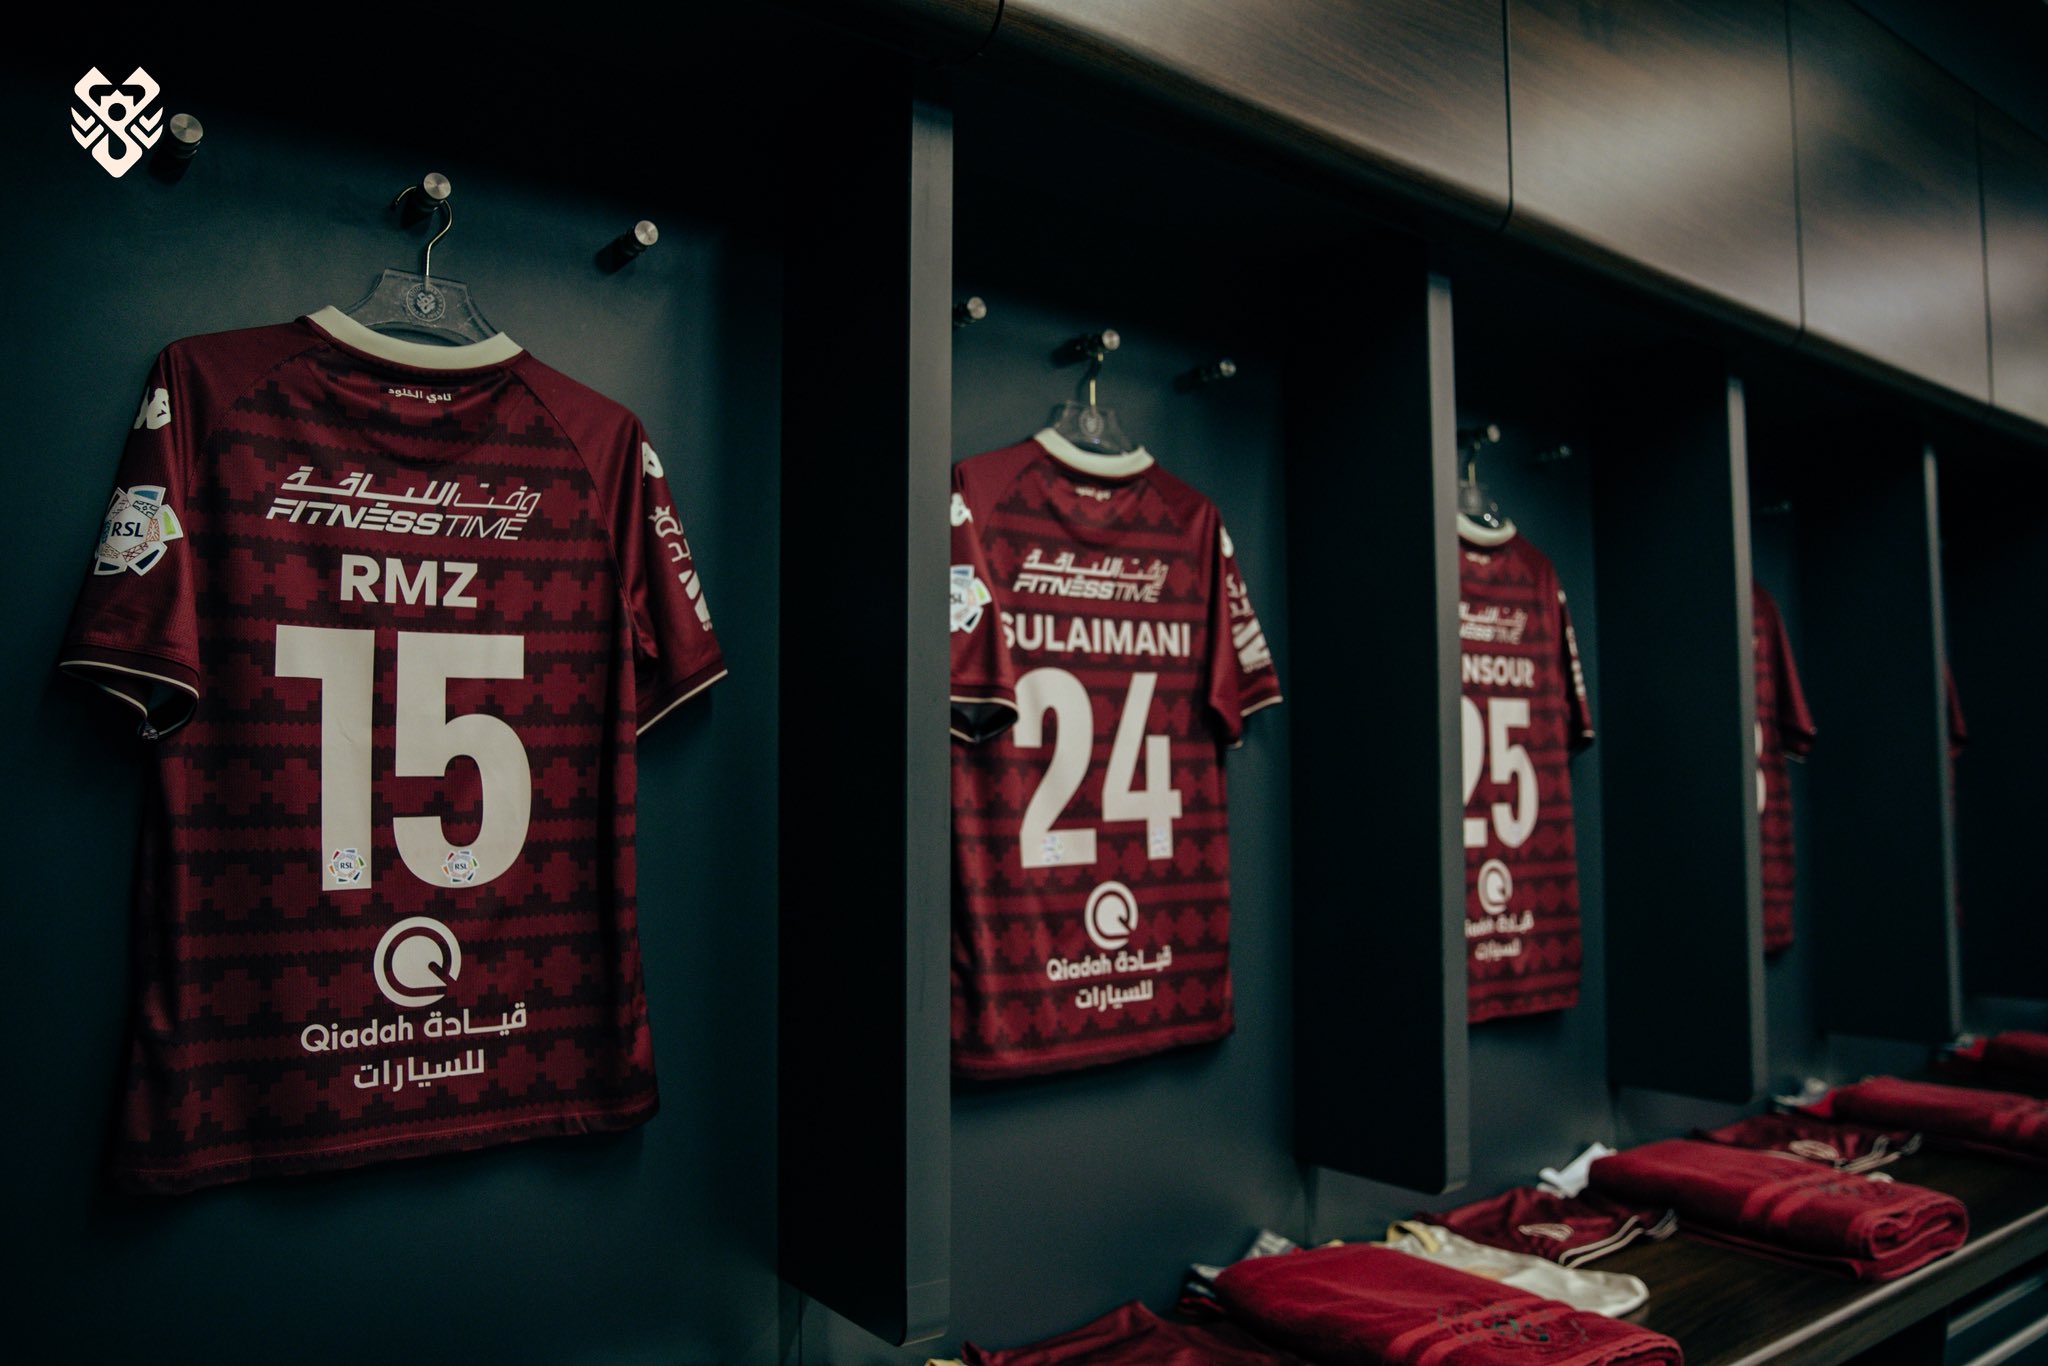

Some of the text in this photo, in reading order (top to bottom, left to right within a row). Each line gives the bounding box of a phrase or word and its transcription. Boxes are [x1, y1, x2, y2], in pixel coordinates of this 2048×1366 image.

[111, 521, 144, 538] RSL
[340, 553, 478, 609] RMZ
[1001, 612, 1190, 657] SULAIMANI
[274, 624, 532, 892] 15
[1013, 668, 1182, 869] 24
[1046, 953, 1112, 982] Qiadah
[1074, 978, 1153, 1013] للسيارات
[301, 1001, 527, 1052] Qiadah قيادة
[353, 1049, 485, 1092] للسيارات
